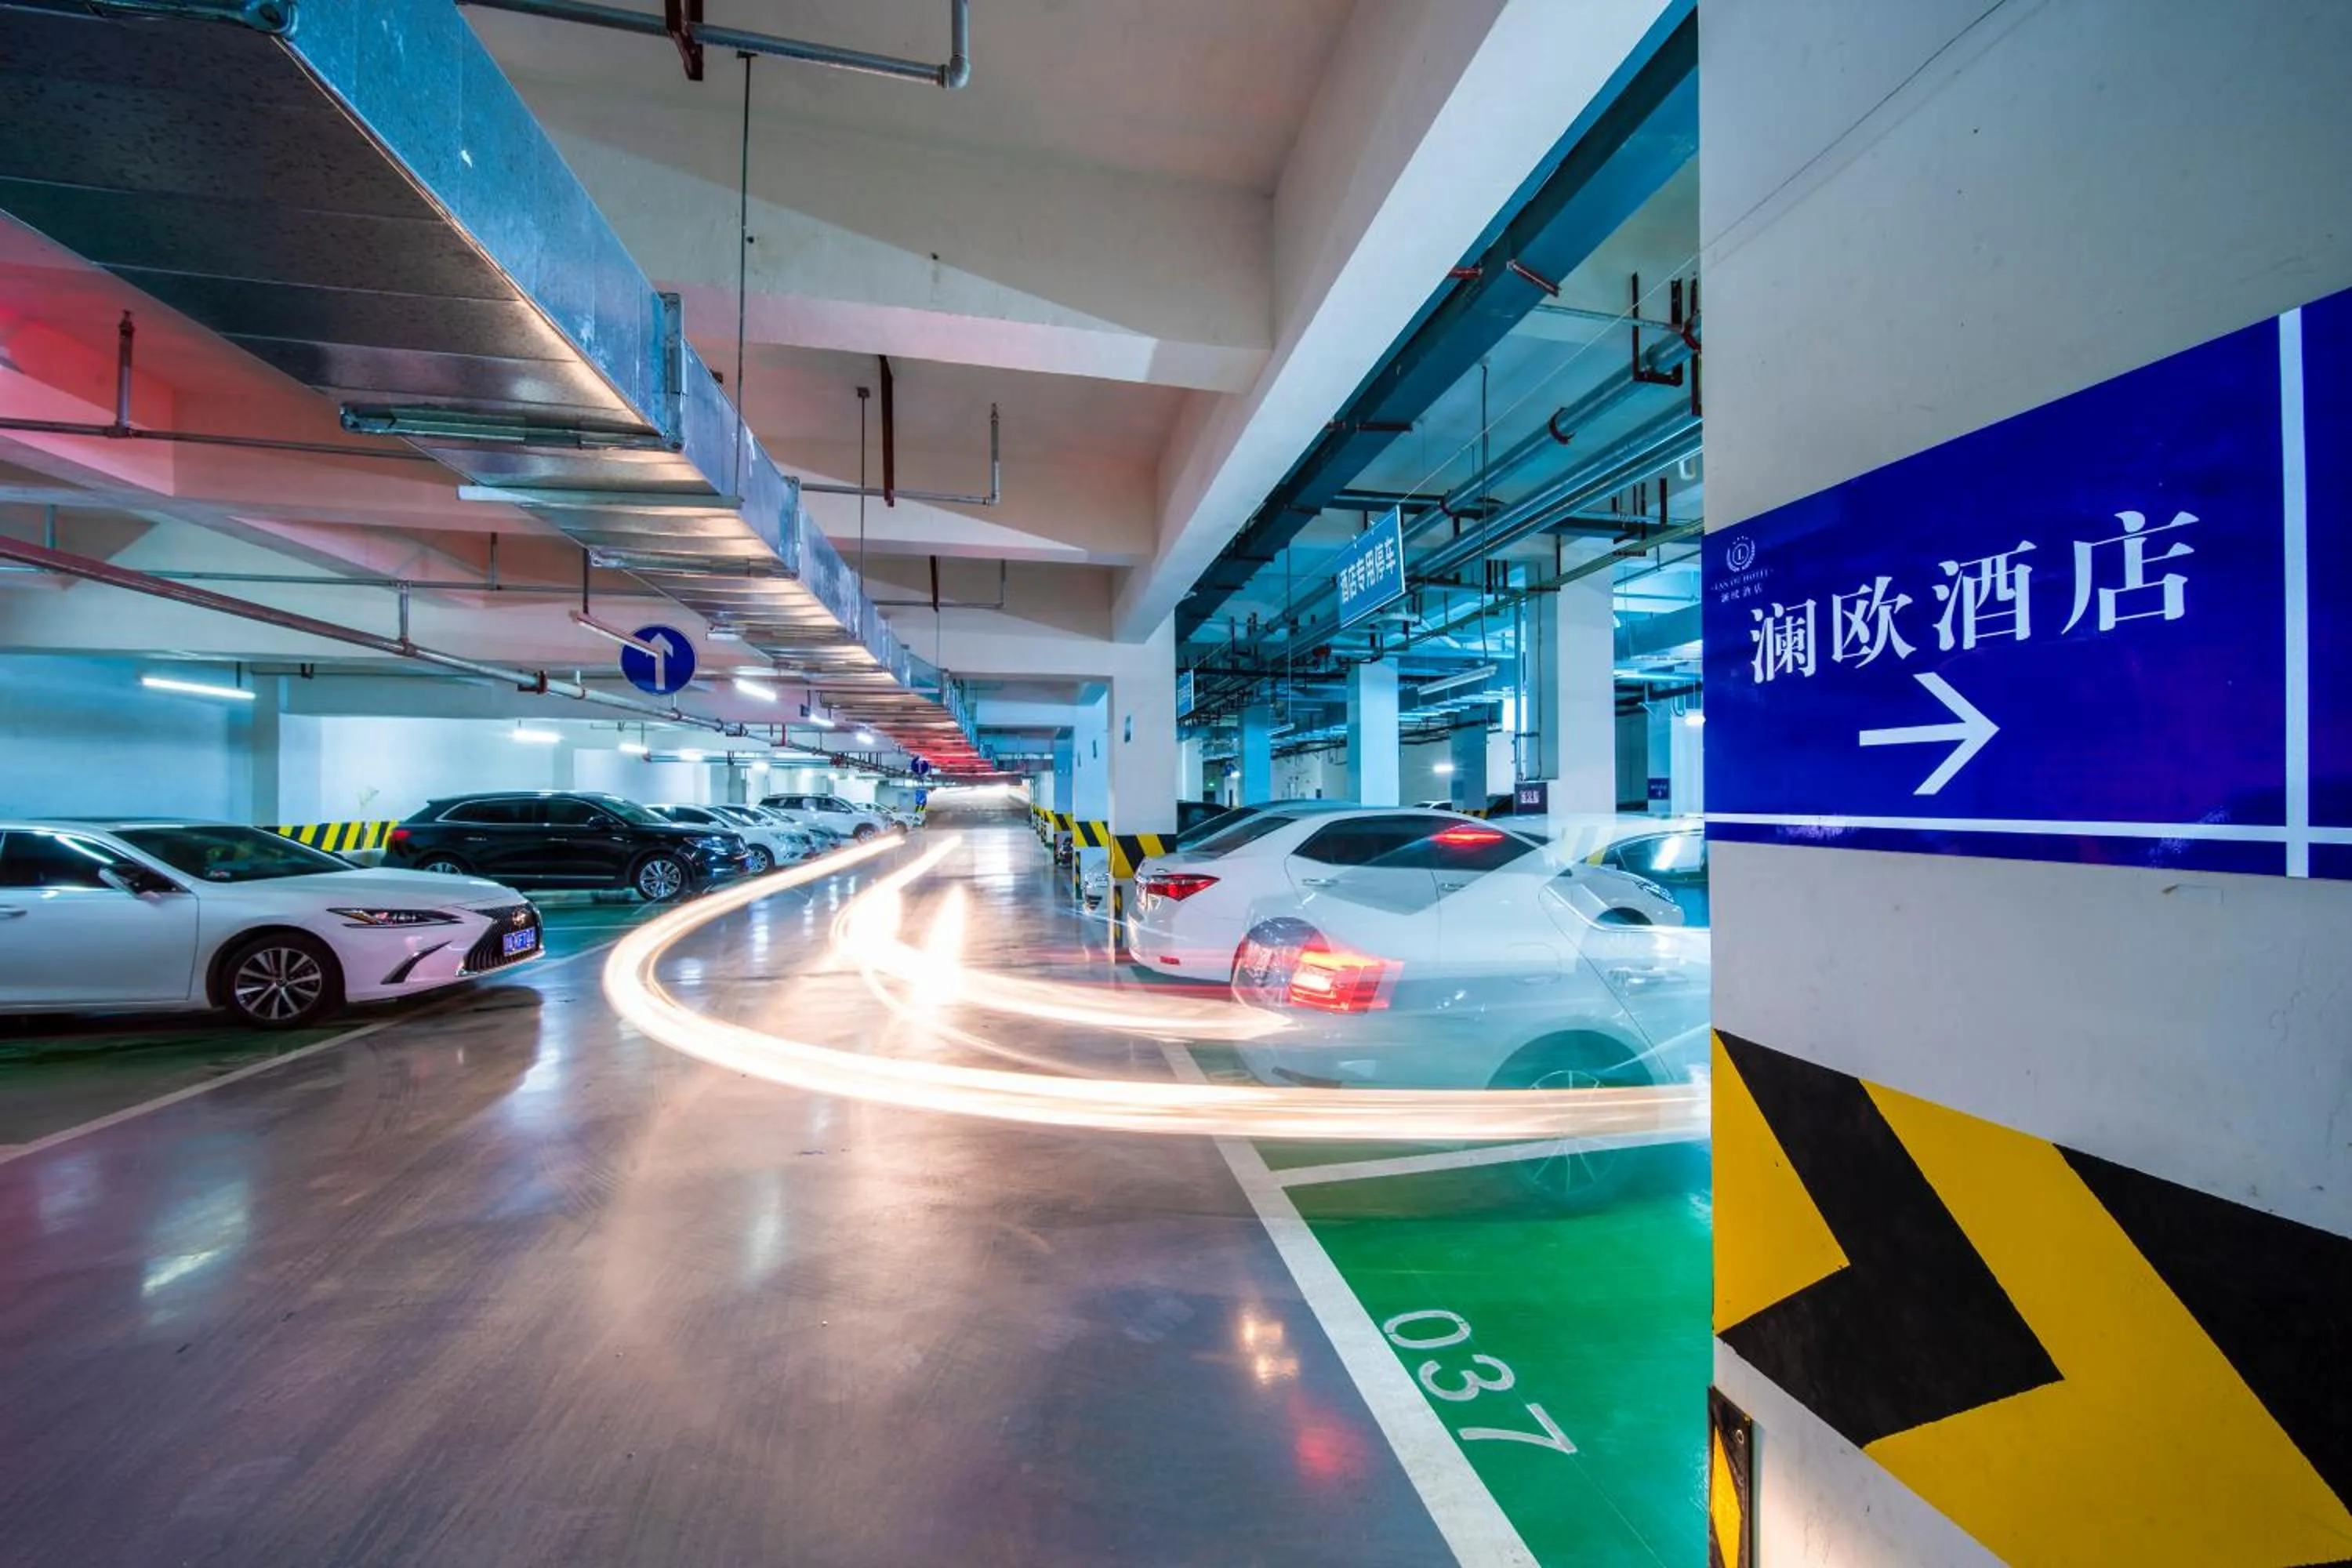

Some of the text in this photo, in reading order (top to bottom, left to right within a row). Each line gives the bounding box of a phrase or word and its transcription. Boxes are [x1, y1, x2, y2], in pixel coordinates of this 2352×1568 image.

[1749, 510, 2200, 684] 澜欧酒店
[1382, 1308, 1577, 1455] 037
